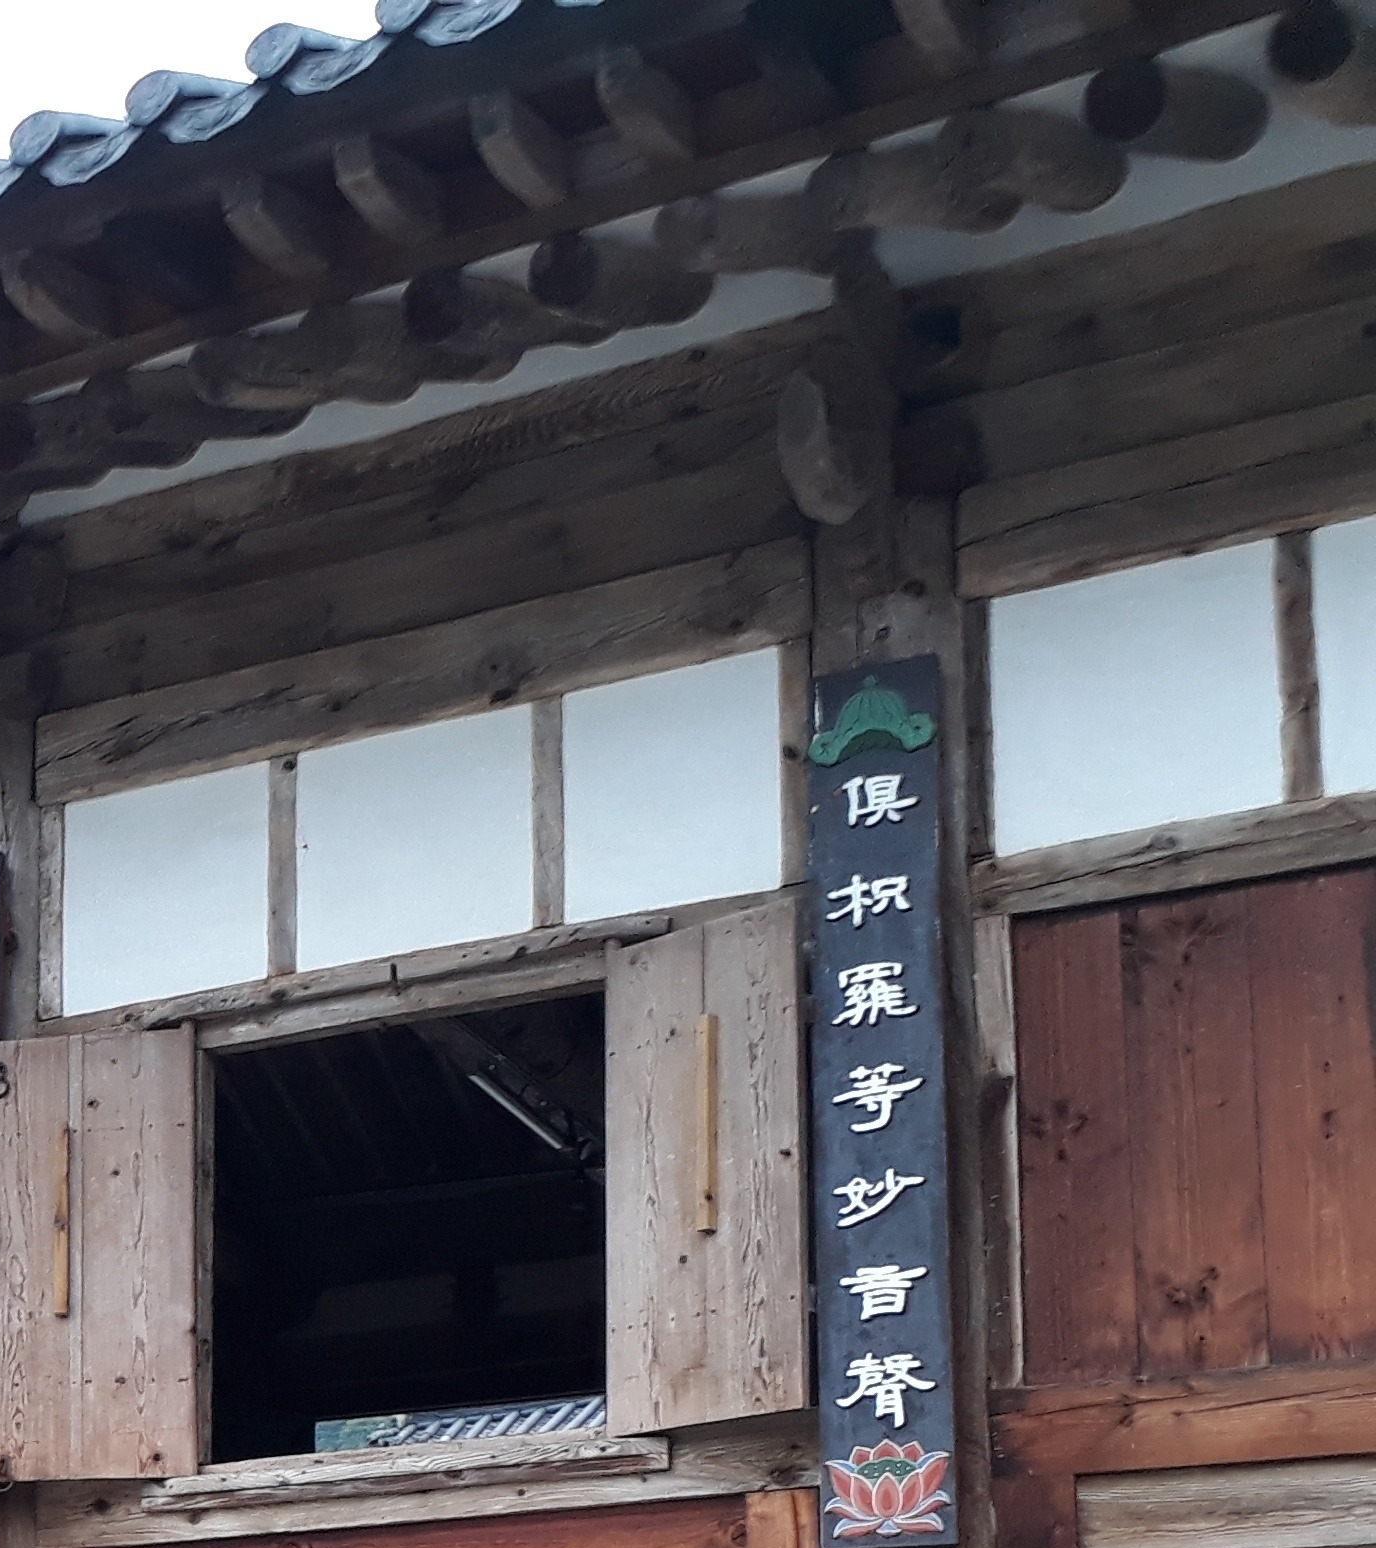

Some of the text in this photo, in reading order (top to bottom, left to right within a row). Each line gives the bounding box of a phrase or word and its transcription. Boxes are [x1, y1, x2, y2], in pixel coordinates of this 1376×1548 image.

[824, 771, 937, 1428] 俱枳羅等妙音聲
